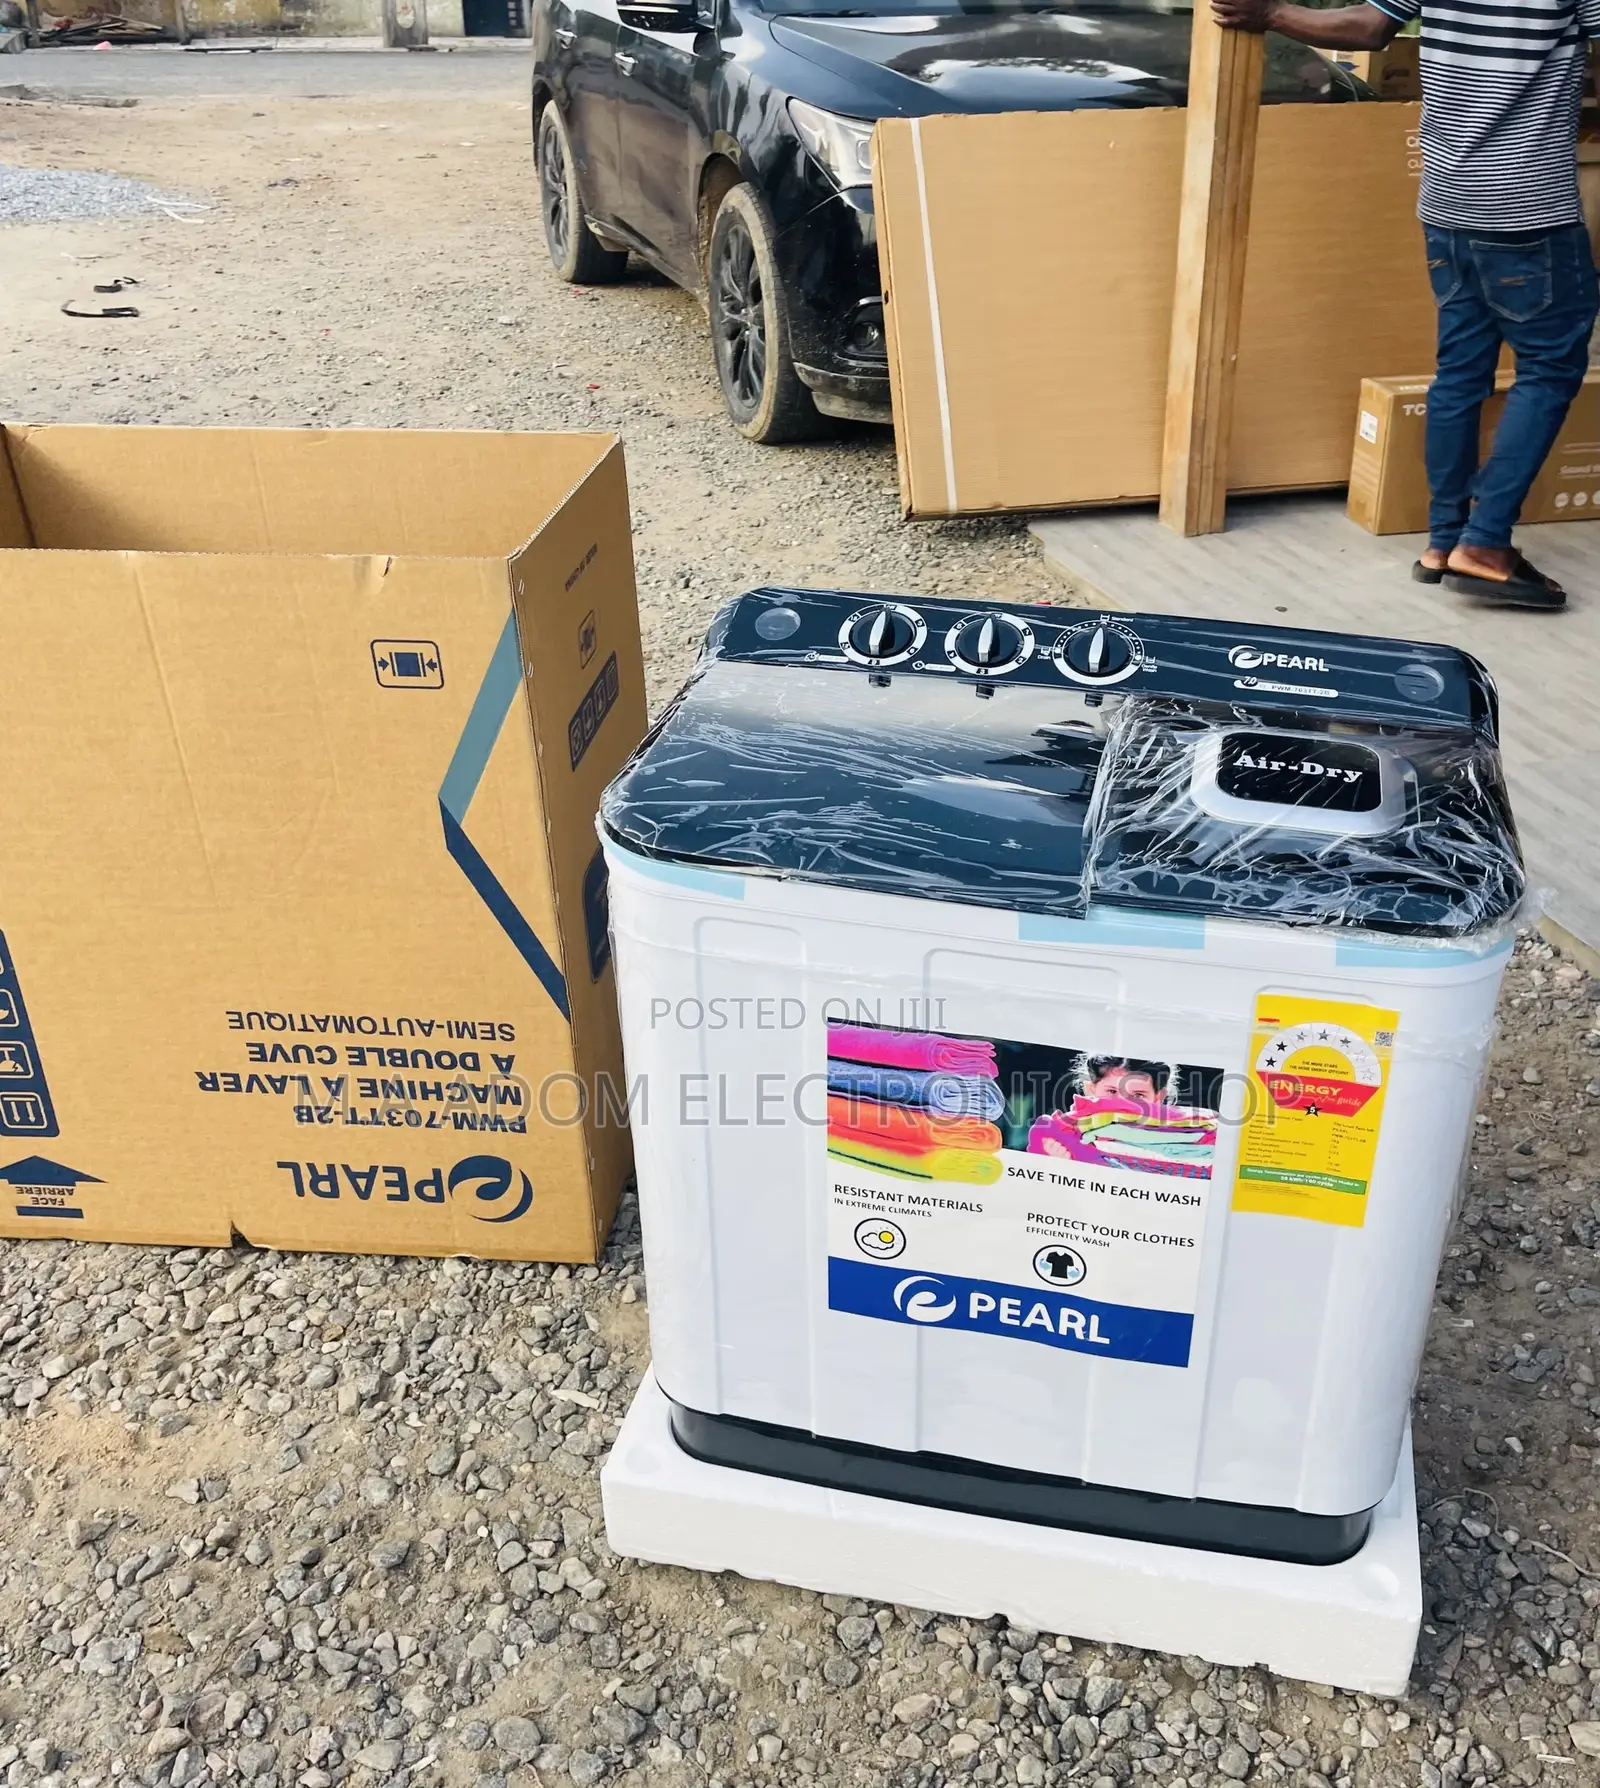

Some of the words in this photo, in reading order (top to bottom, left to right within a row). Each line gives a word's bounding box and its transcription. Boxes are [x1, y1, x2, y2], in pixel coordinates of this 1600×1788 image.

[1402, 404, 1427, 416] TC
[1263, 652, 1330, 672] PEARL
[1233, 754, 1363, 783] Air-Dry
[225, 1011, 516, 1042] SEMI-AUTOMATIQUE
[246, 1042, 337, 1065] CUVE
[345, 1046, 481, 1071] DOUBLE
[194, 1071, 311, 1096] LAVER
[357, 1078, 522, 1106] MACHINE
[1269, 1080, 1343, 1096] ENERGY
[293, 1105, 527, 1134] PWM-703TT-2B
[276, 1161, 445, 1203] PEARL
[1008, 1167, 1045, 1181] SAVE
[1049, 1173, 1085, 1189] TIME
[1090, 1181, 1105, 1193] IN
[1110, 1185, 1150, 1200] EACH
[1155, 1192, 1201, 1206] WASH
[31, 1197, 65, 1206] FACE
[834, 1184, 904, 1203] RESISTANT
[908, 1195, 983, 1213] MATERIALS
[846, 1200, 886, 1212] EXTREME
[888, 1206, 932, 1217] CLIMATES
[1026, 1226, 1080, 1241] EFFICIENTLY
[1083, 1237, 1110, 1248] WASH
[1027, 1212, 1088, 1231] PROTECT
[1091, 1224, 1130, 1240] YOUR
[1134, 1232, 1195, 1248] CLOTHES
[968, 1292, 1111, 1345] PEARL
